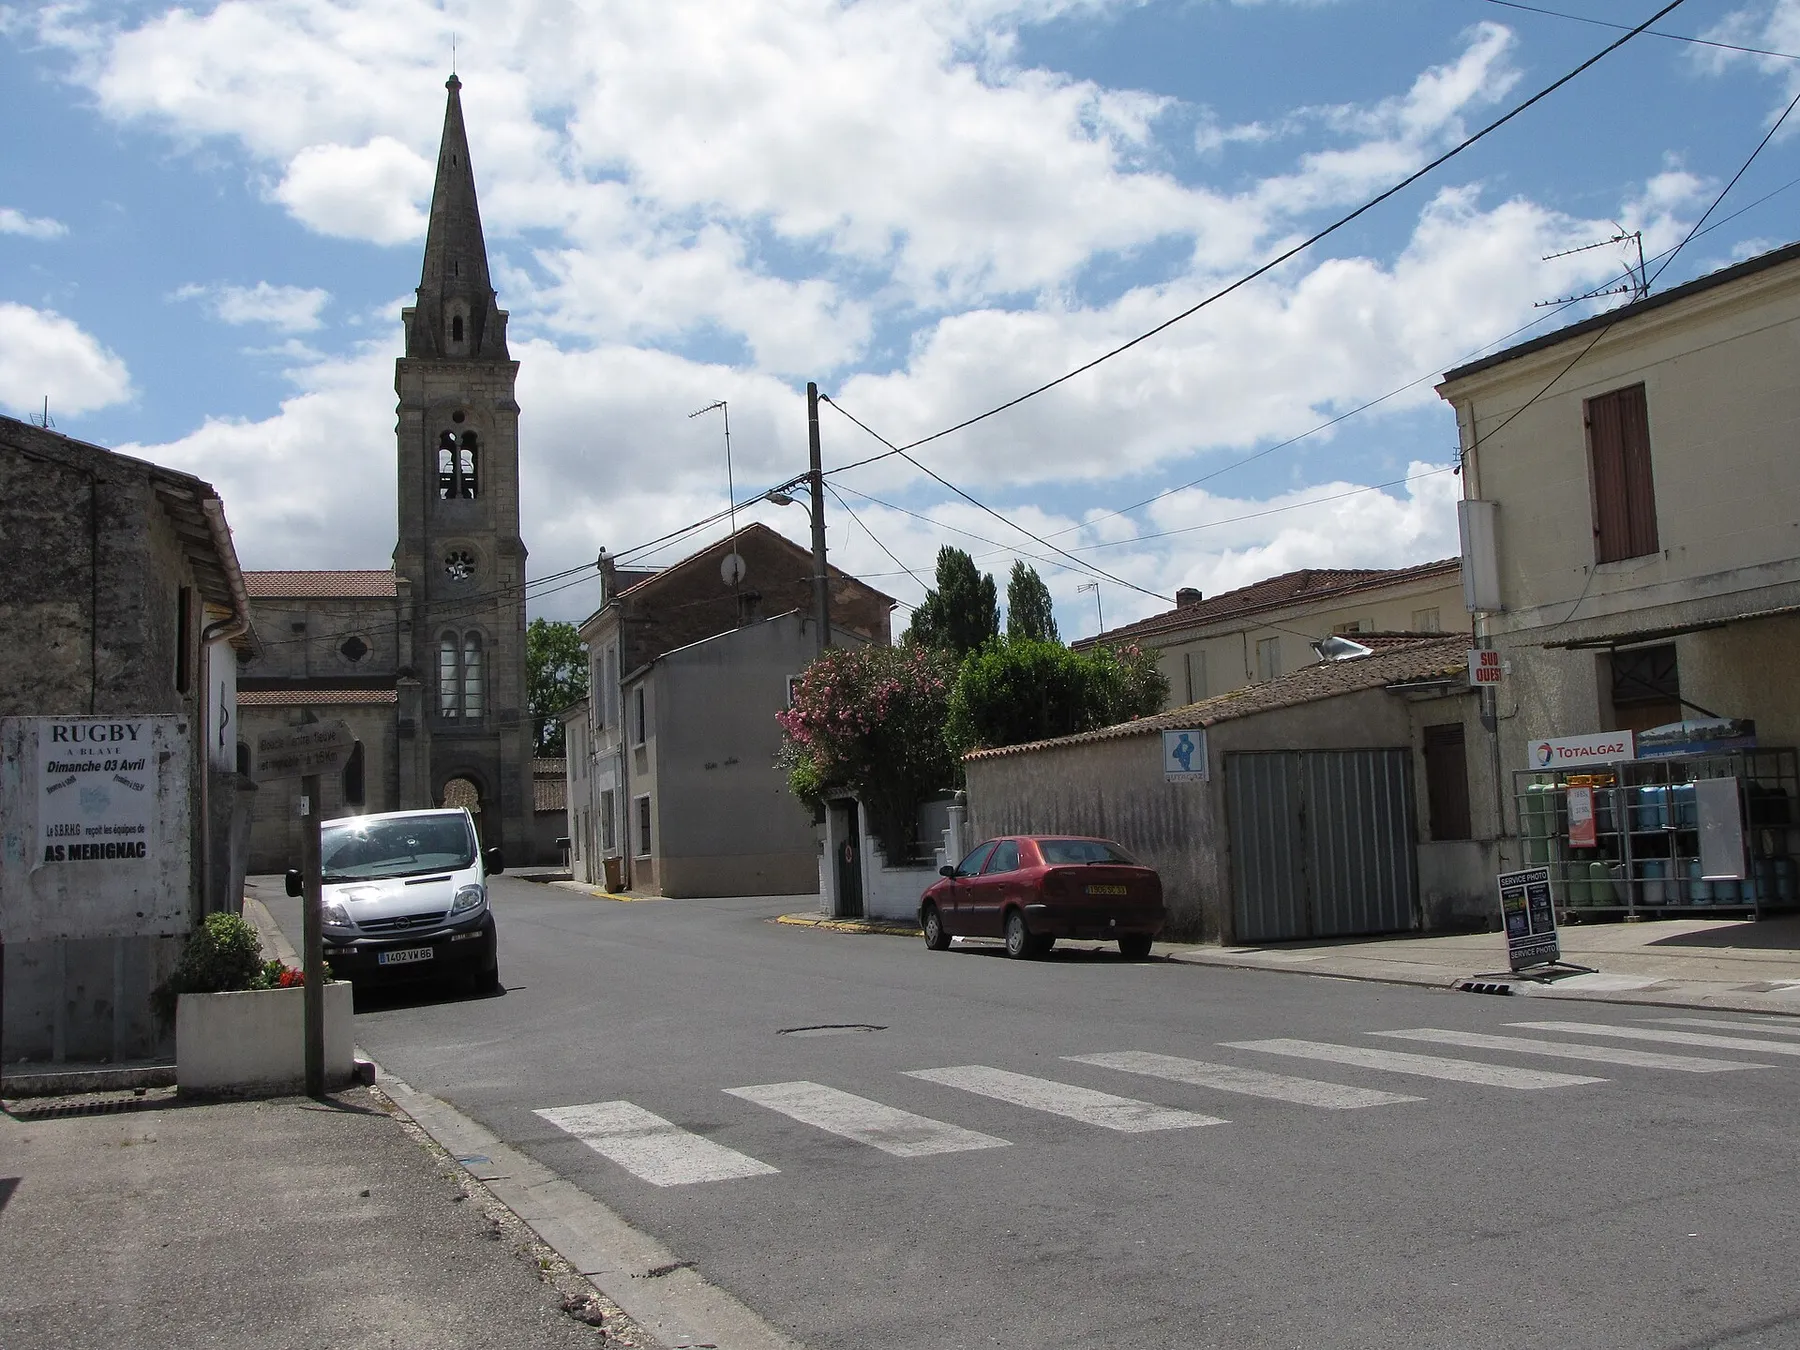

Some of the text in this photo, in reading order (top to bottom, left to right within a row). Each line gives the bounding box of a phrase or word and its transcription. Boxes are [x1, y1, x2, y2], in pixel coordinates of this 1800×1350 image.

[1480, 651, 1499, 666] SUD
[1476, 667, 1502, 682] OUEST
[51, 723, 142, 743] RUGBY
[80, 747, 121, 756] BLAYE
[1556, 743, 1624, 759] TOTALGAZ
[47, 758, 146, 773] Dimanche 03 Avril
[46, 824, 54, 837] Le
[85, 825, 103, 838] reçoit
[103, 824, 112, 834] les
[113, 823, 137, 837] équipes
[137, 823, 145, 834] de
[44, 841, 146, 862] AS MERIGNAC
[1501, 871, 1547, 886] SERVICE PHOTO
[386, 952, 406, 963] 1402
[420, 949, 431, 958] 86
[1511, 944, 1556, 960] SERVICE PHOTO
